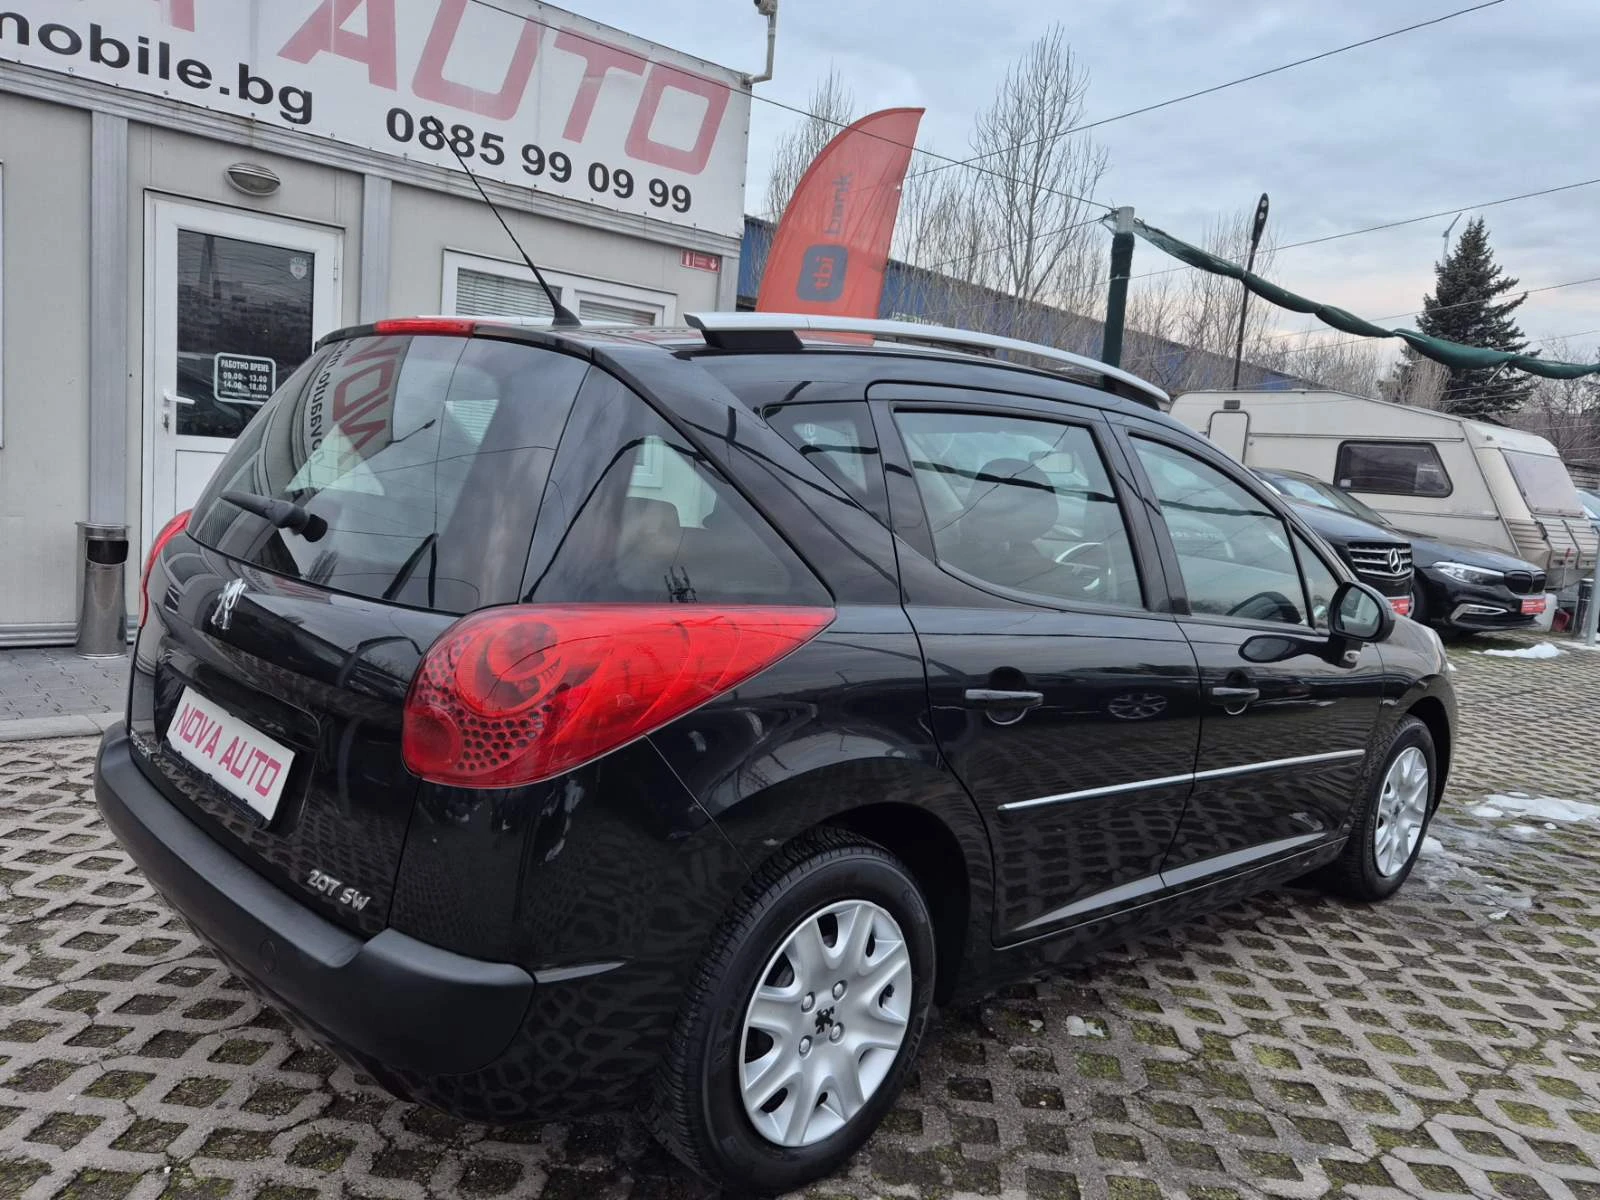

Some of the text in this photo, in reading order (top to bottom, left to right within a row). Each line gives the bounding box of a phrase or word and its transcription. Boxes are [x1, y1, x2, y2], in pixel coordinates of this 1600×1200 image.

[277, 0, 731, 175] AUTO
[386, 107, 692, 213] 0885 99 09 99
[812, 172, 853, 290] tbi bank
[221, 359, 249, 370] РАБОТНО
[223, 372, 243, 380] 09.00
[223, 380, 242, 389] 14.00
[173, 703, 222, 759] NOVA
[218, 735, 282, 797] AUTO
[306, 869, 371, 911] 207 SW
